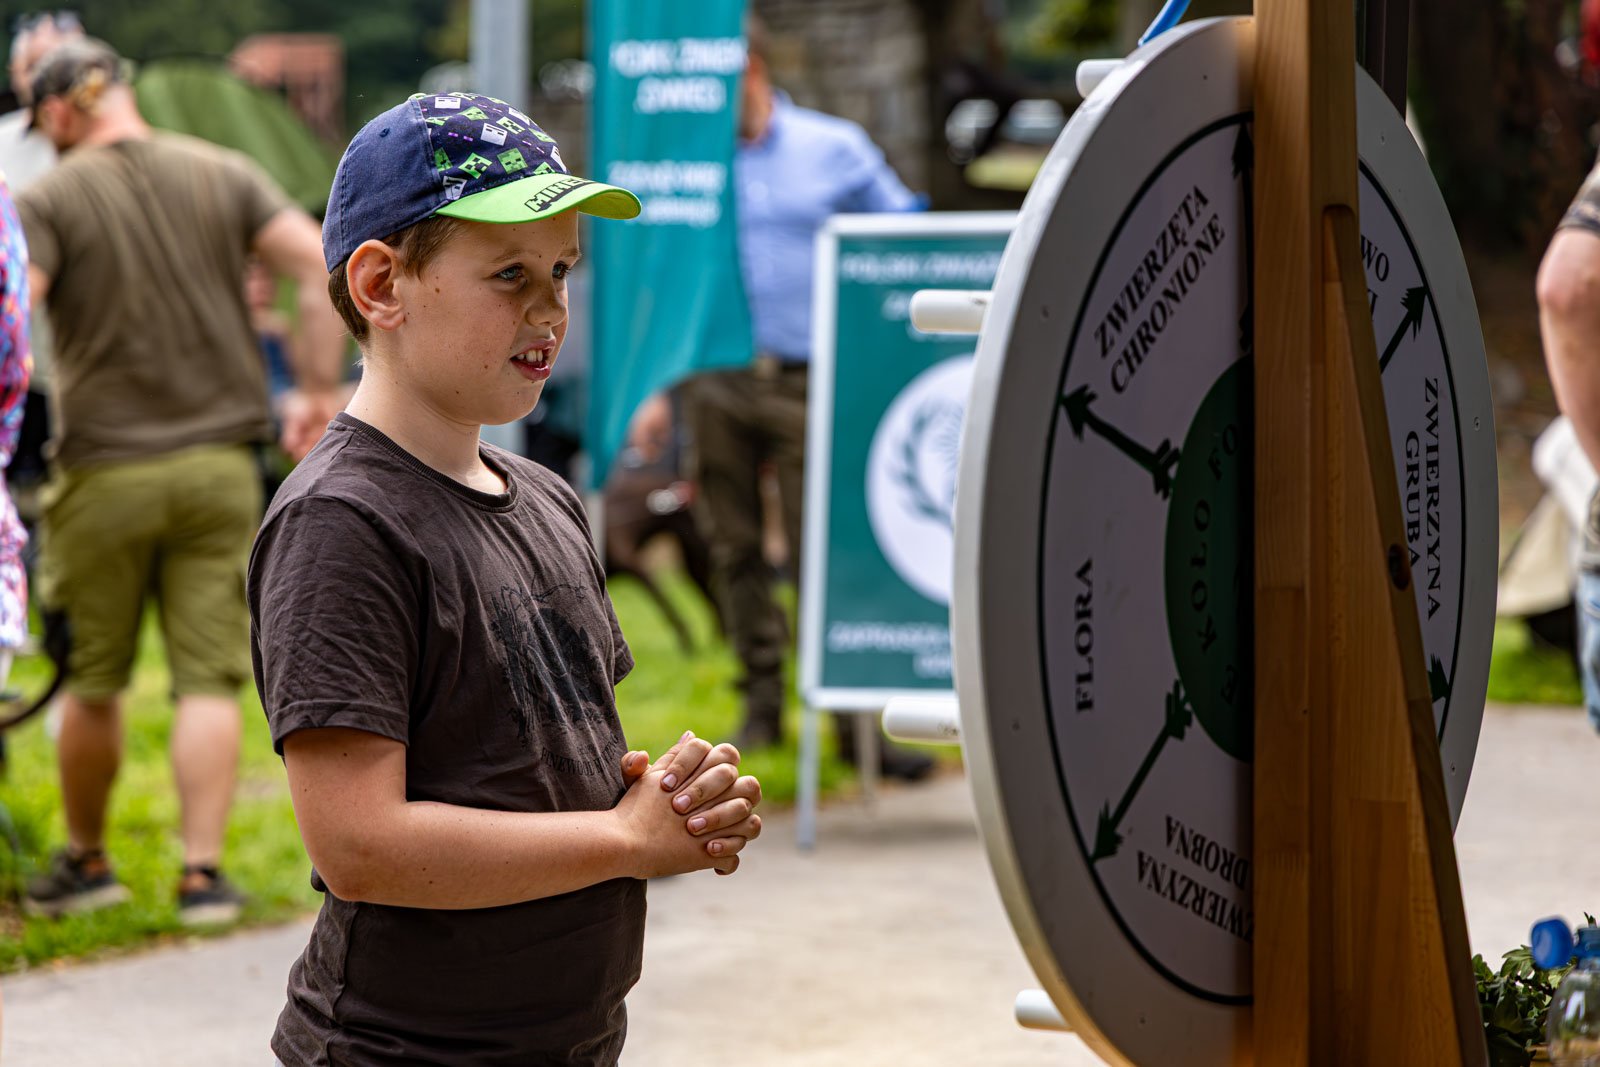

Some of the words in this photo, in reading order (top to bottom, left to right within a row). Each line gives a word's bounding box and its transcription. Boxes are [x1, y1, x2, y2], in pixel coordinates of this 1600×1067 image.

[1094, 186, 1209, 358] ZWIERZĘTA
[1111, 214, 1225, 394] CHRONIONE
[1405, 430, 1421, 568] GRUBA
[1424, 377, 1441, 619] ZWIERZYNA
[1074, 557, 1094, 713] FLORA
[1166, 814, 1250, 891] DROBNA
